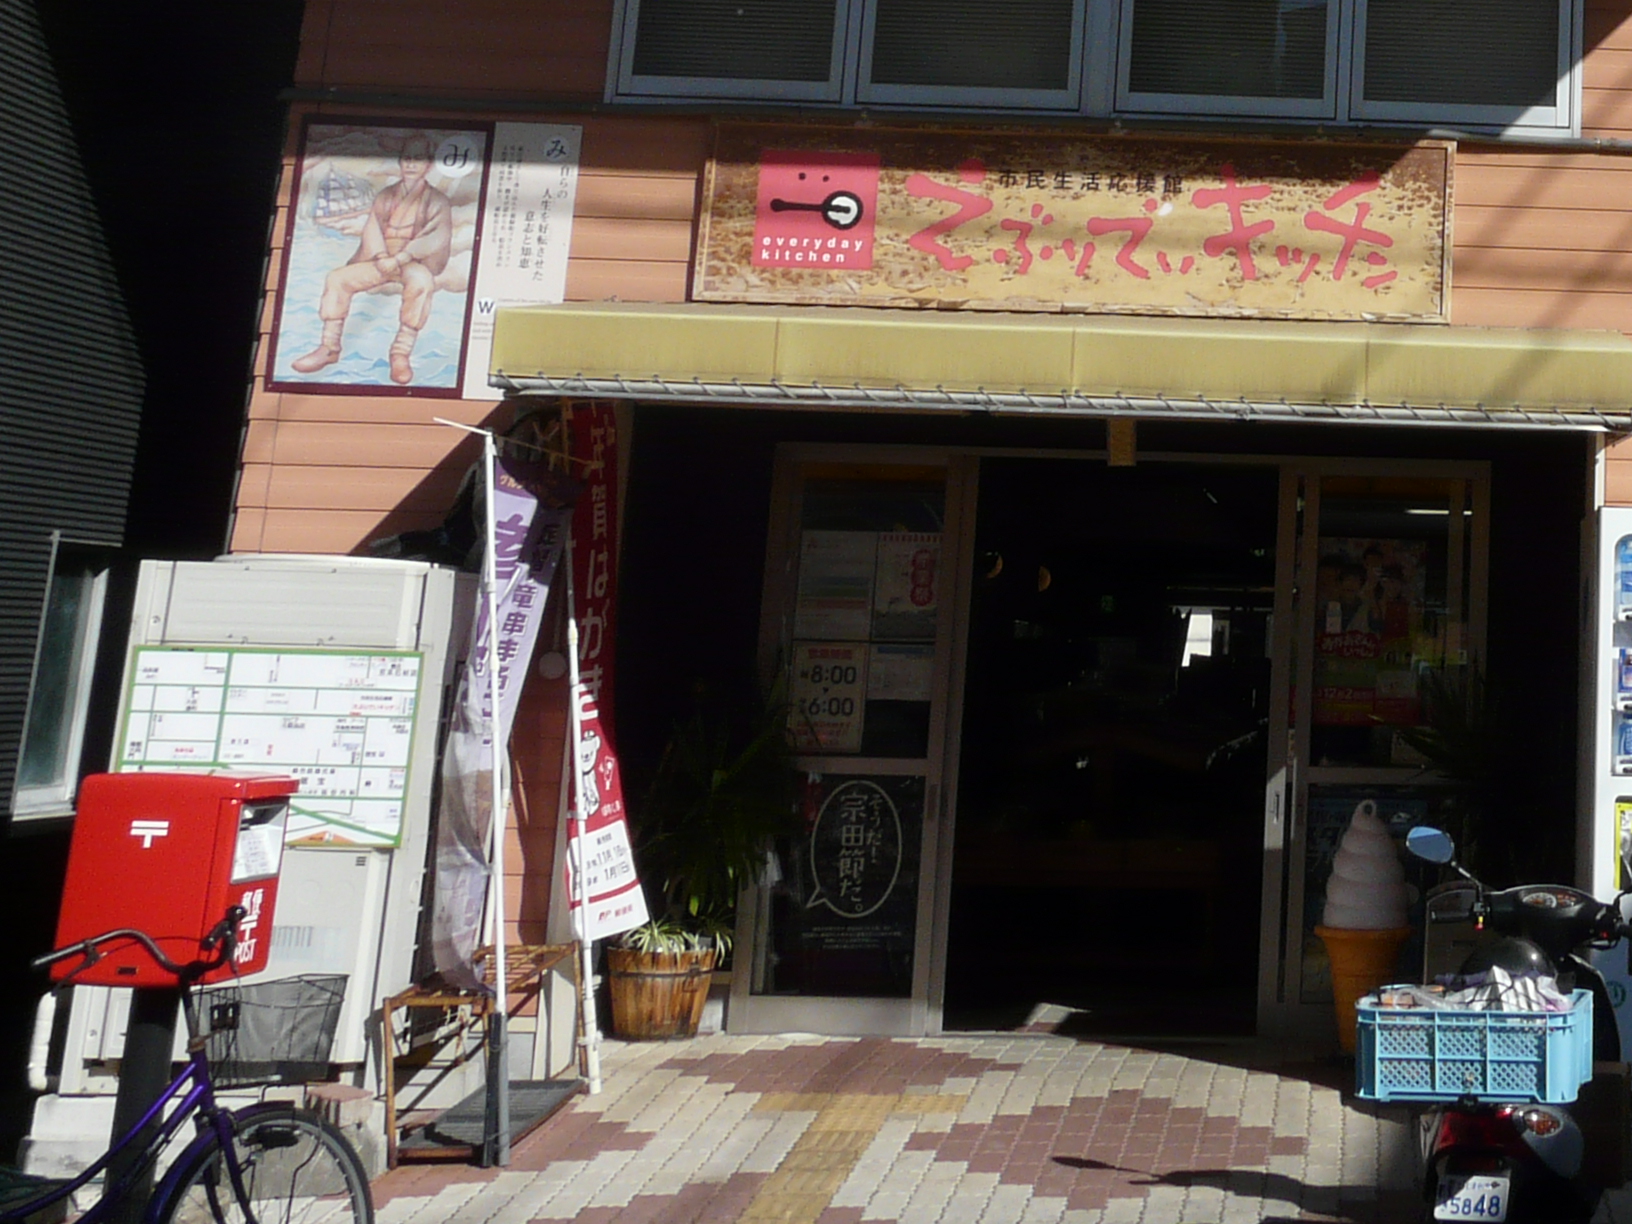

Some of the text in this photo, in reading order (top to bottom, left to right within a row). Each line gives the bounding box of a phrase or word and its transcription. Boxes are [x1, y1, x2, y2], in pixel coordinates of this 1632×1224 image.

[1000, 170, 1184, 194] 市民生活応援館
[762, 236, 863, 251] everyday
[761, 249, 846, 263] kitchen
[478, 301, 494, 314] W
[810, 664, 857, 685] 8:00
[808, 696, 854, 716] 6:00
[839, 791, 869, 913] 宗田節だ。
[234, 938, 257, 965] POST
[1450, 1193, 1501, 1217] 5848
